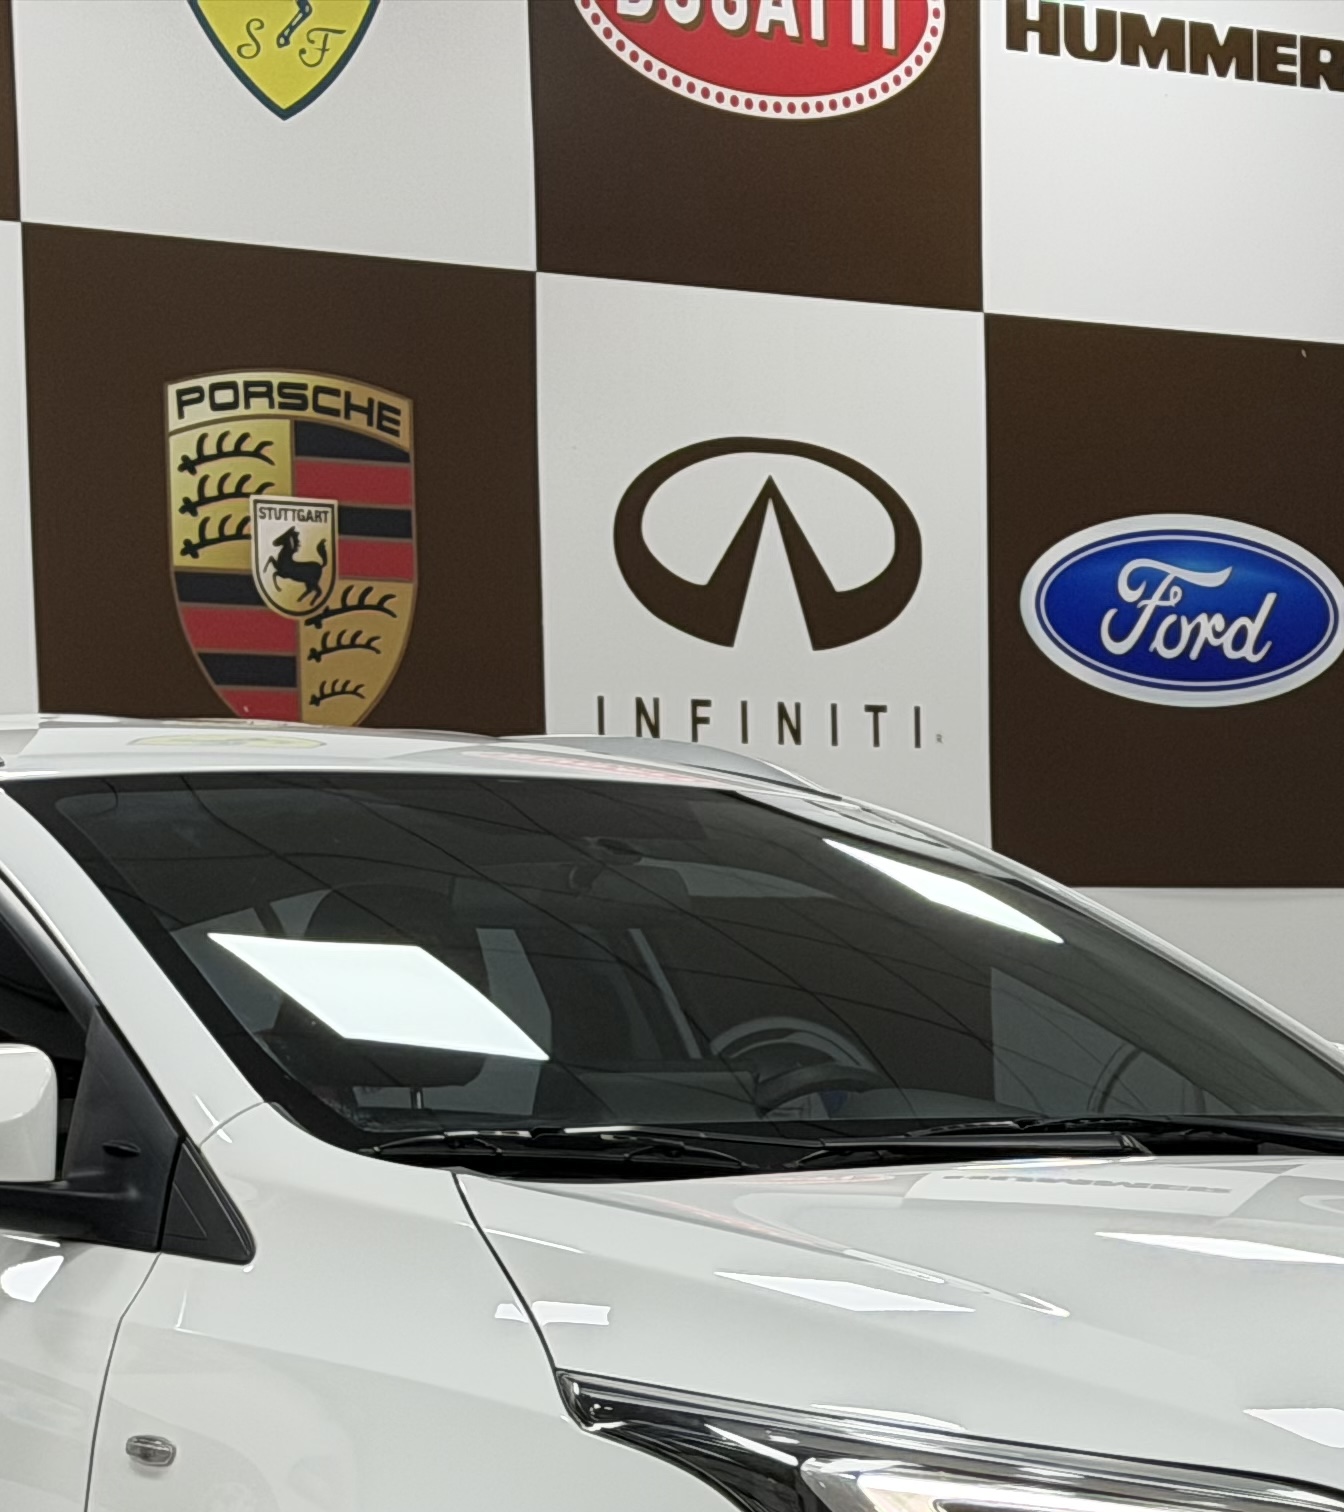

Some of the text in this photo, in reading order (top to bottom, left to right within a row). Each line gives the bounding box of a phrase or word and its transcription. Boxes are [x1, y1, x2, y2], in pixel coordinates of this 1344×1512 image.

[175, 380, 402, 438] PORSCHE
[258, 506, 329, 524] STUTTGART
[1100, 558, 1278, 663] Ford
[596, 695, 922, 749] INFINITI
